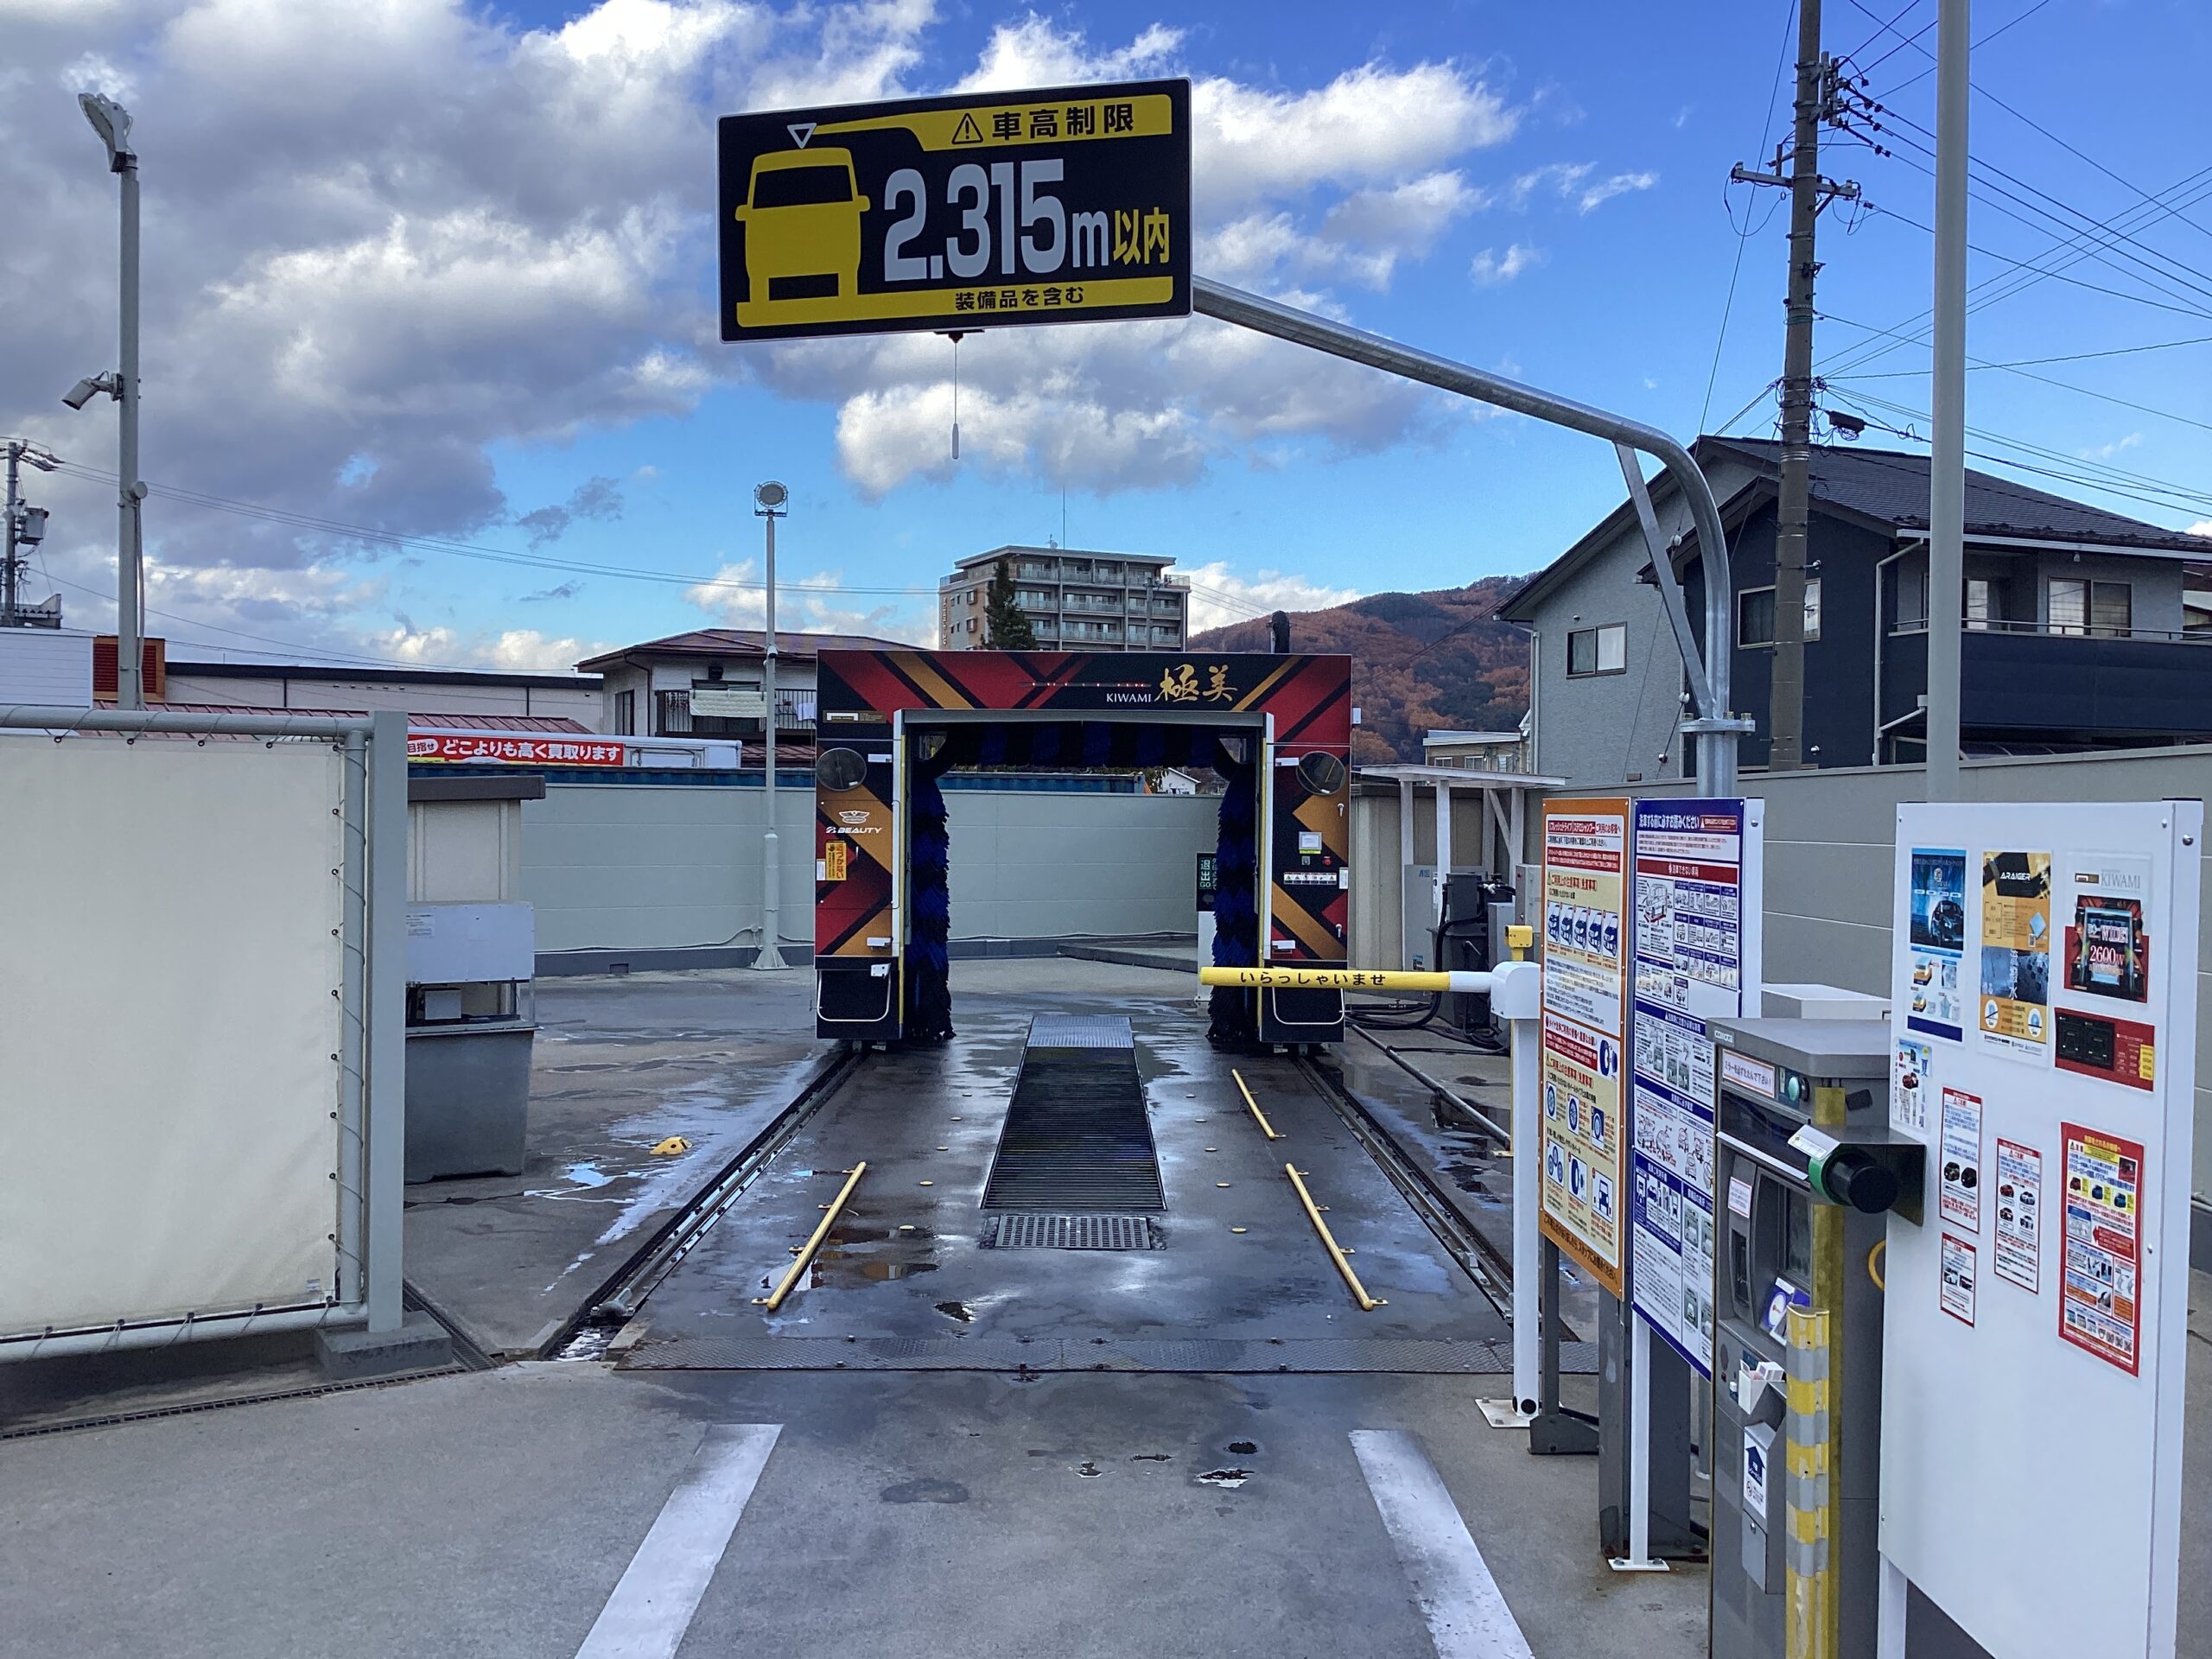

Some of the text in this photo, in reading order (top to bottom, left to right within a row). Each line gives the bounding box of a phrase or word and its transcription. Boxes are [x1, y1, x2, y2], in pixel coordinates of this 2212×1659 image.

[992, 103, 1134, 141] 車高制限
[884, 158, 1170, 282] 2.315m以内
[955, 286, 1084, 310] 装備品を含む
[1154, 664, 1238, 702] 極美
[1106, 693, 1152, 702] KIWAMI
[442, 739, 620, 762] どこよりも高く買取ります
[2101, 873, 2141, 889] KIWAMI
[1240, 970, 1386, 986] いらっしゃいませ
